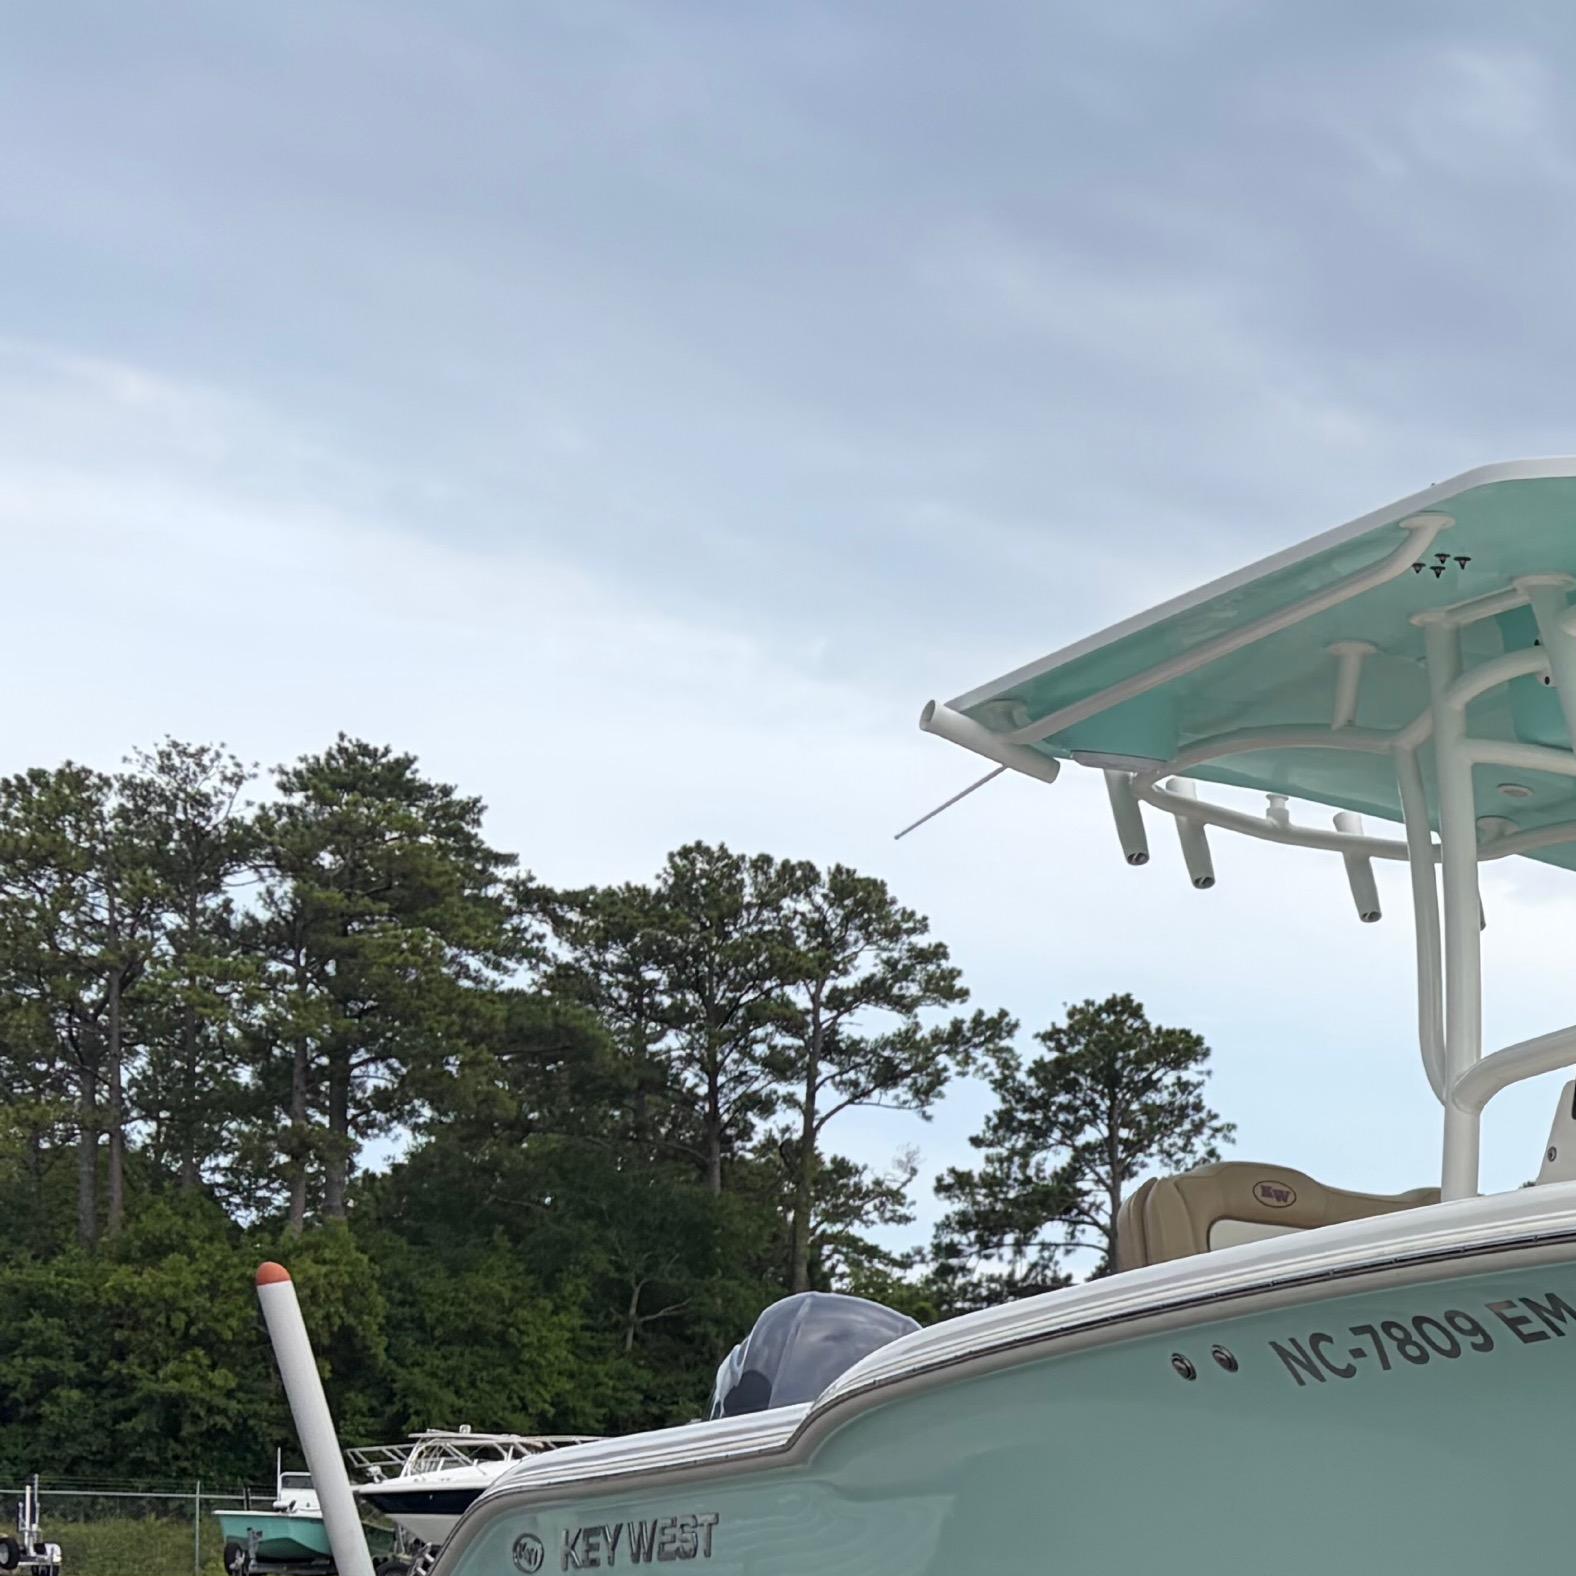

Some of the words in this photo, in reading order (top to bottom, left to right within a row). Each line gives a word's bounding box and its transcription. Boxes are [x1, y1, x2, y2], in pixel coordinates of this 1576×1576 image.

[1268, 1310, 1494, 1386] NC-7809
[560, 1522, 624, 1572] KEY
[627, 1512, 719, 1564] WEST
